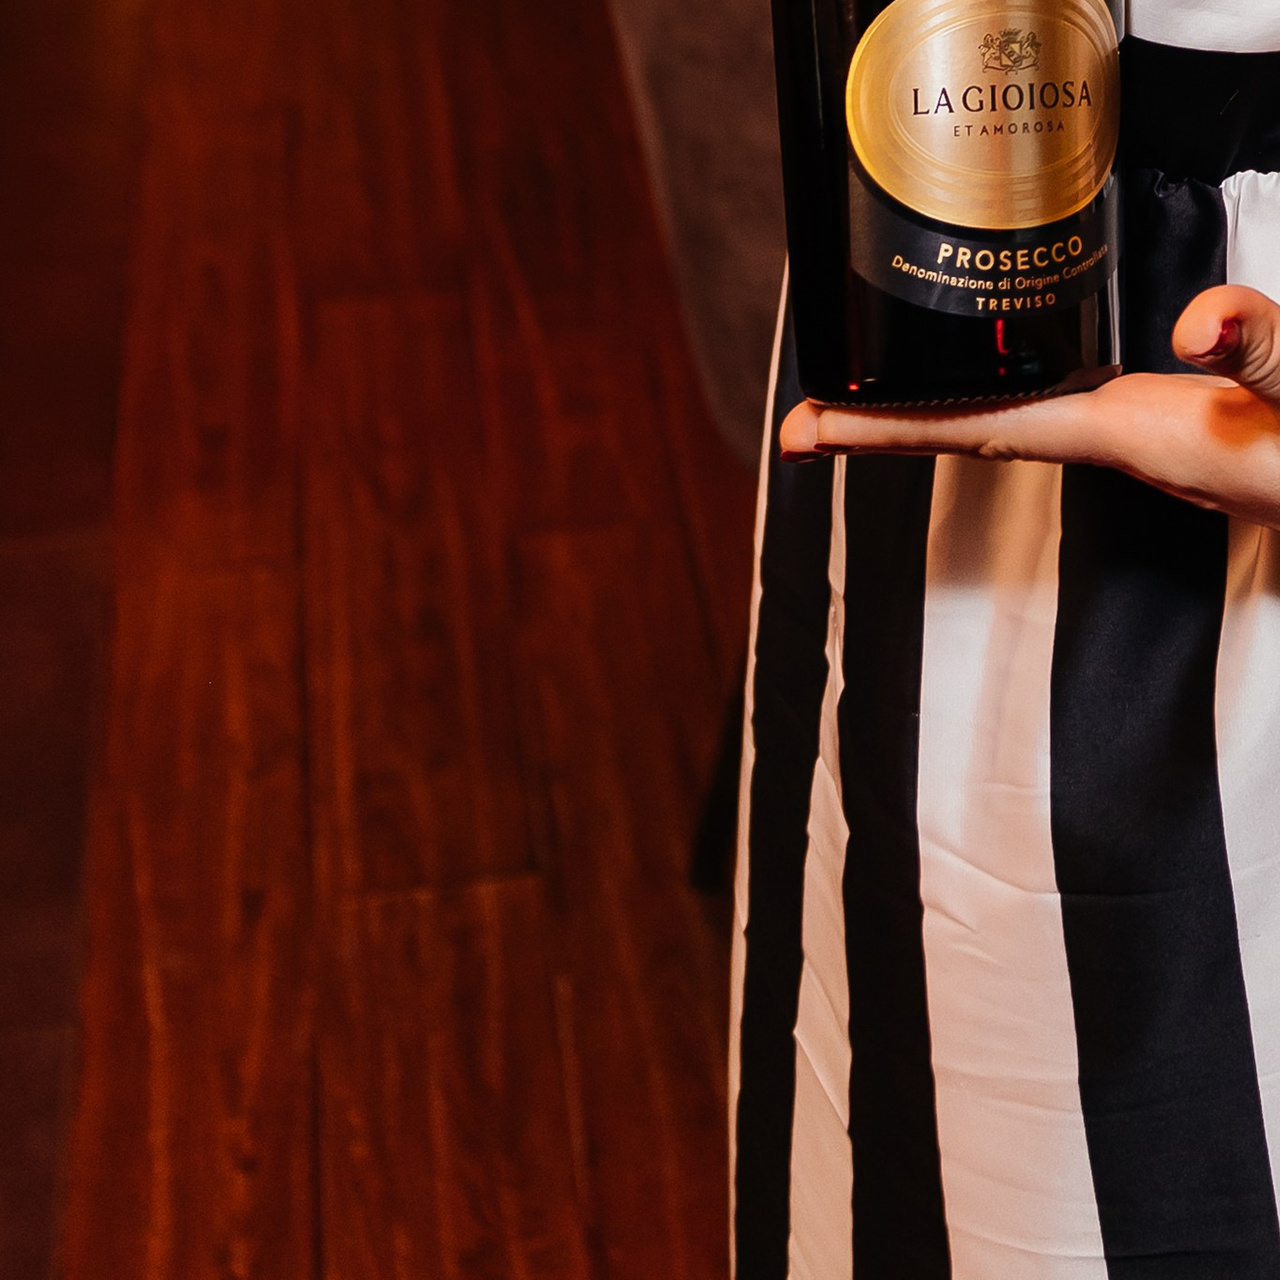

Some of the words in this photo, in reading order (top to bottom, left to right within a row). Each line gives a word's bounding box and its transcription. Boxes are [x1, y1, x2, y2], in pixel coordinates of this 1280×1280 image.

[936, 235, 1083, 272] PROSECCO
[891, 254, 994, 290] Denominazione
[997, 277, 1011, 290] di
[1015, 274, 1060, 290] Origine
[975, 292, 1056, 311] TREVISO
